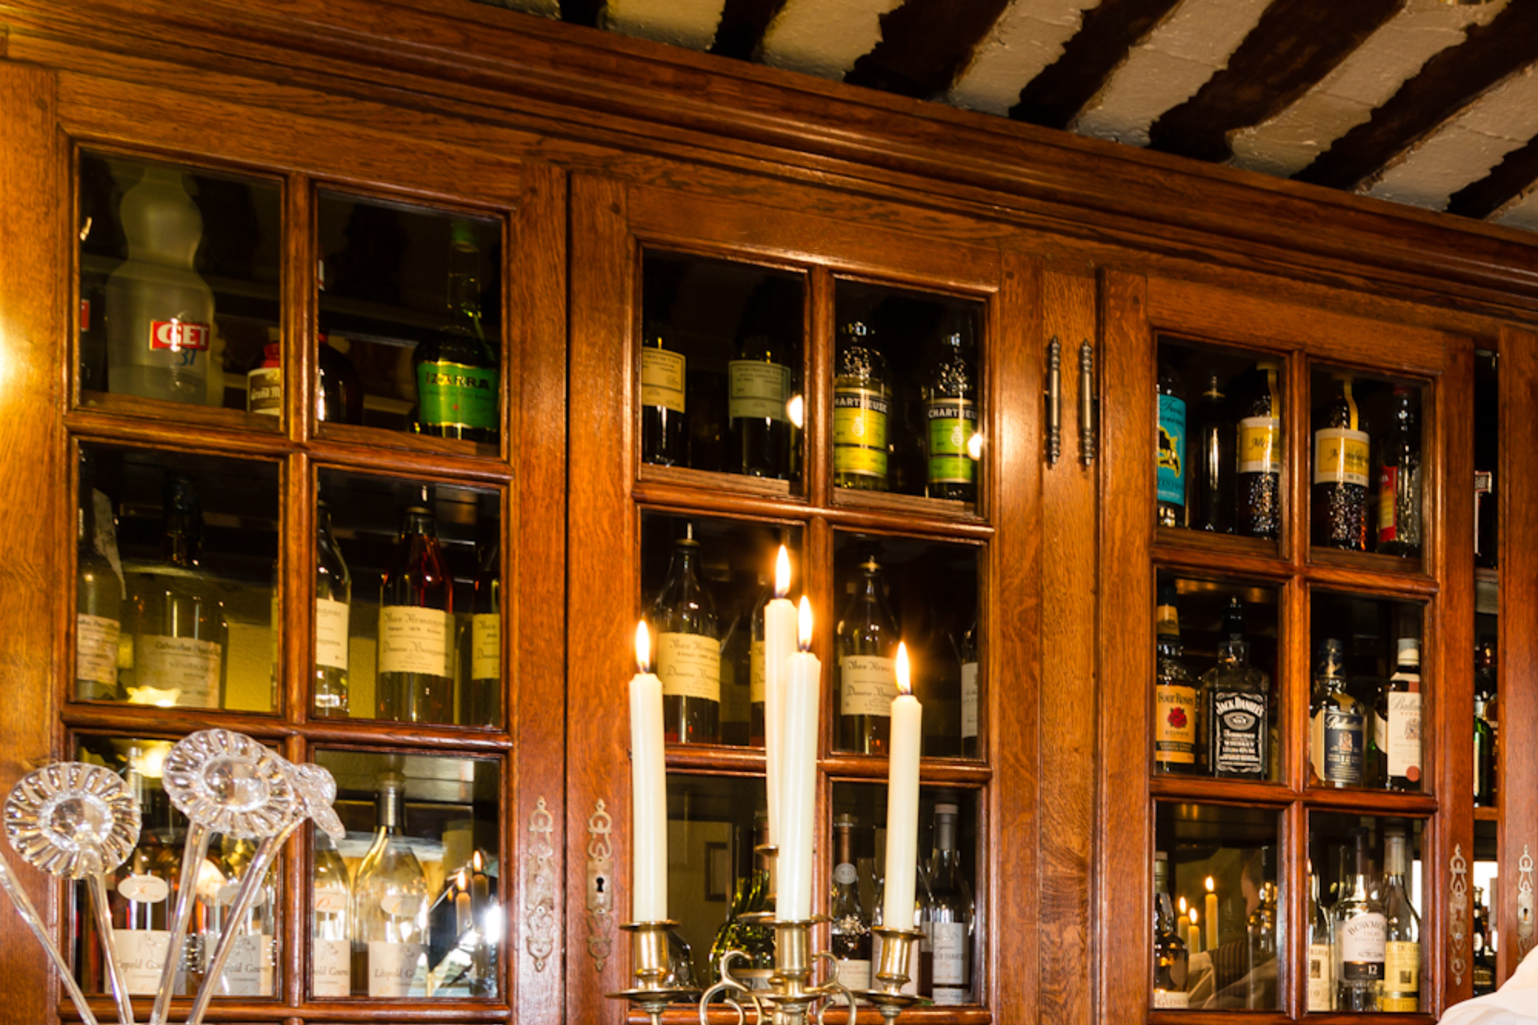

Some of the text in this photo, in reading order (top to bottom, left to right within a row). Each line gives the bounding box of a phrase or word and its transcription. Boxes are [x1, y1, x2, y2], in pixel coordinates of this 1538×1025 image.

[157, 323, 209, 346] GET
[426, 372, 490, 391] IZARRA
[1158, 692, 1176, 704] Four
[1215, 700, 1236, 716] JACK
[1347, 920, 1385, 936] BOWMO
[1367, 964, 1378, 976] 12
